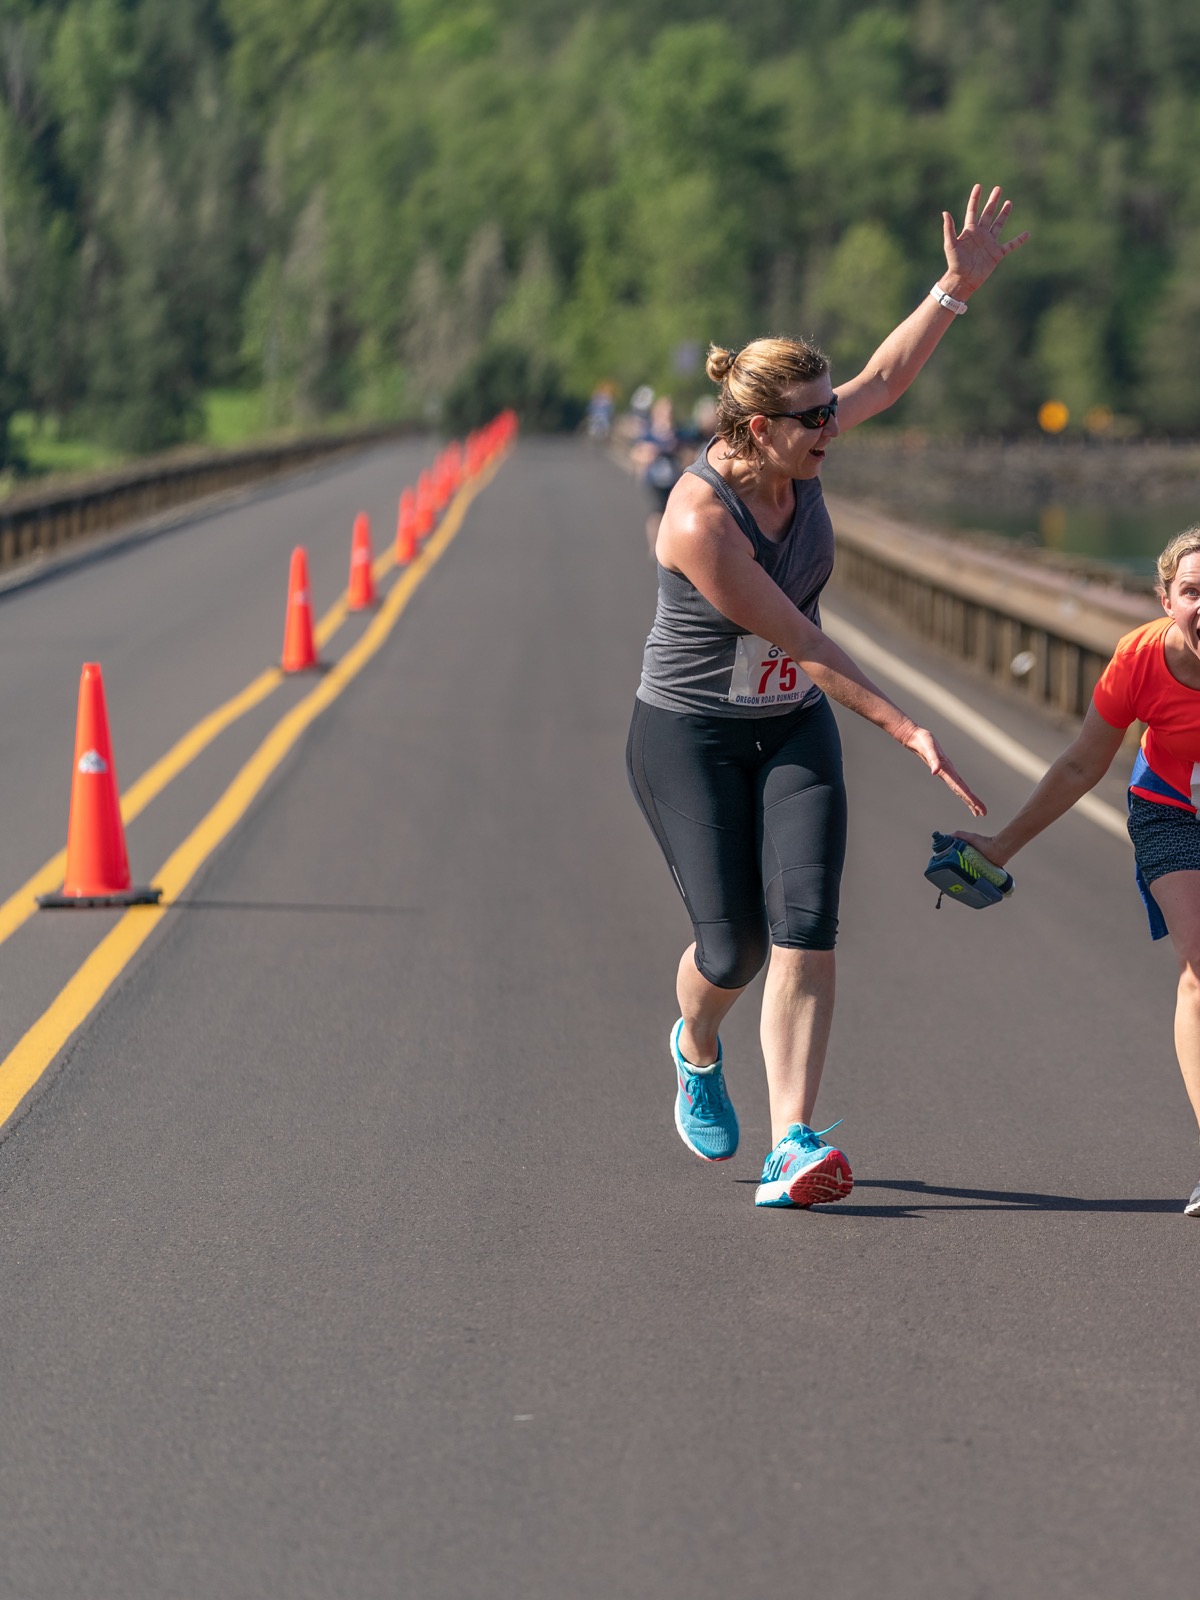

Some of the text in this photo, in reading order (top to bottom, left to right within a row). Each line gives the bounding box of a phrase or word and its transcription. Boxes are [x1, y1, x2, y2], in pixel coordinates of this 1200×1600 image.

[758, 658, 797, 694] 75
[736, 695, 760, 705] OREGON
[761, 695, 775, 704] ROAD
[777, 692, 799, 702] RUNNERS
